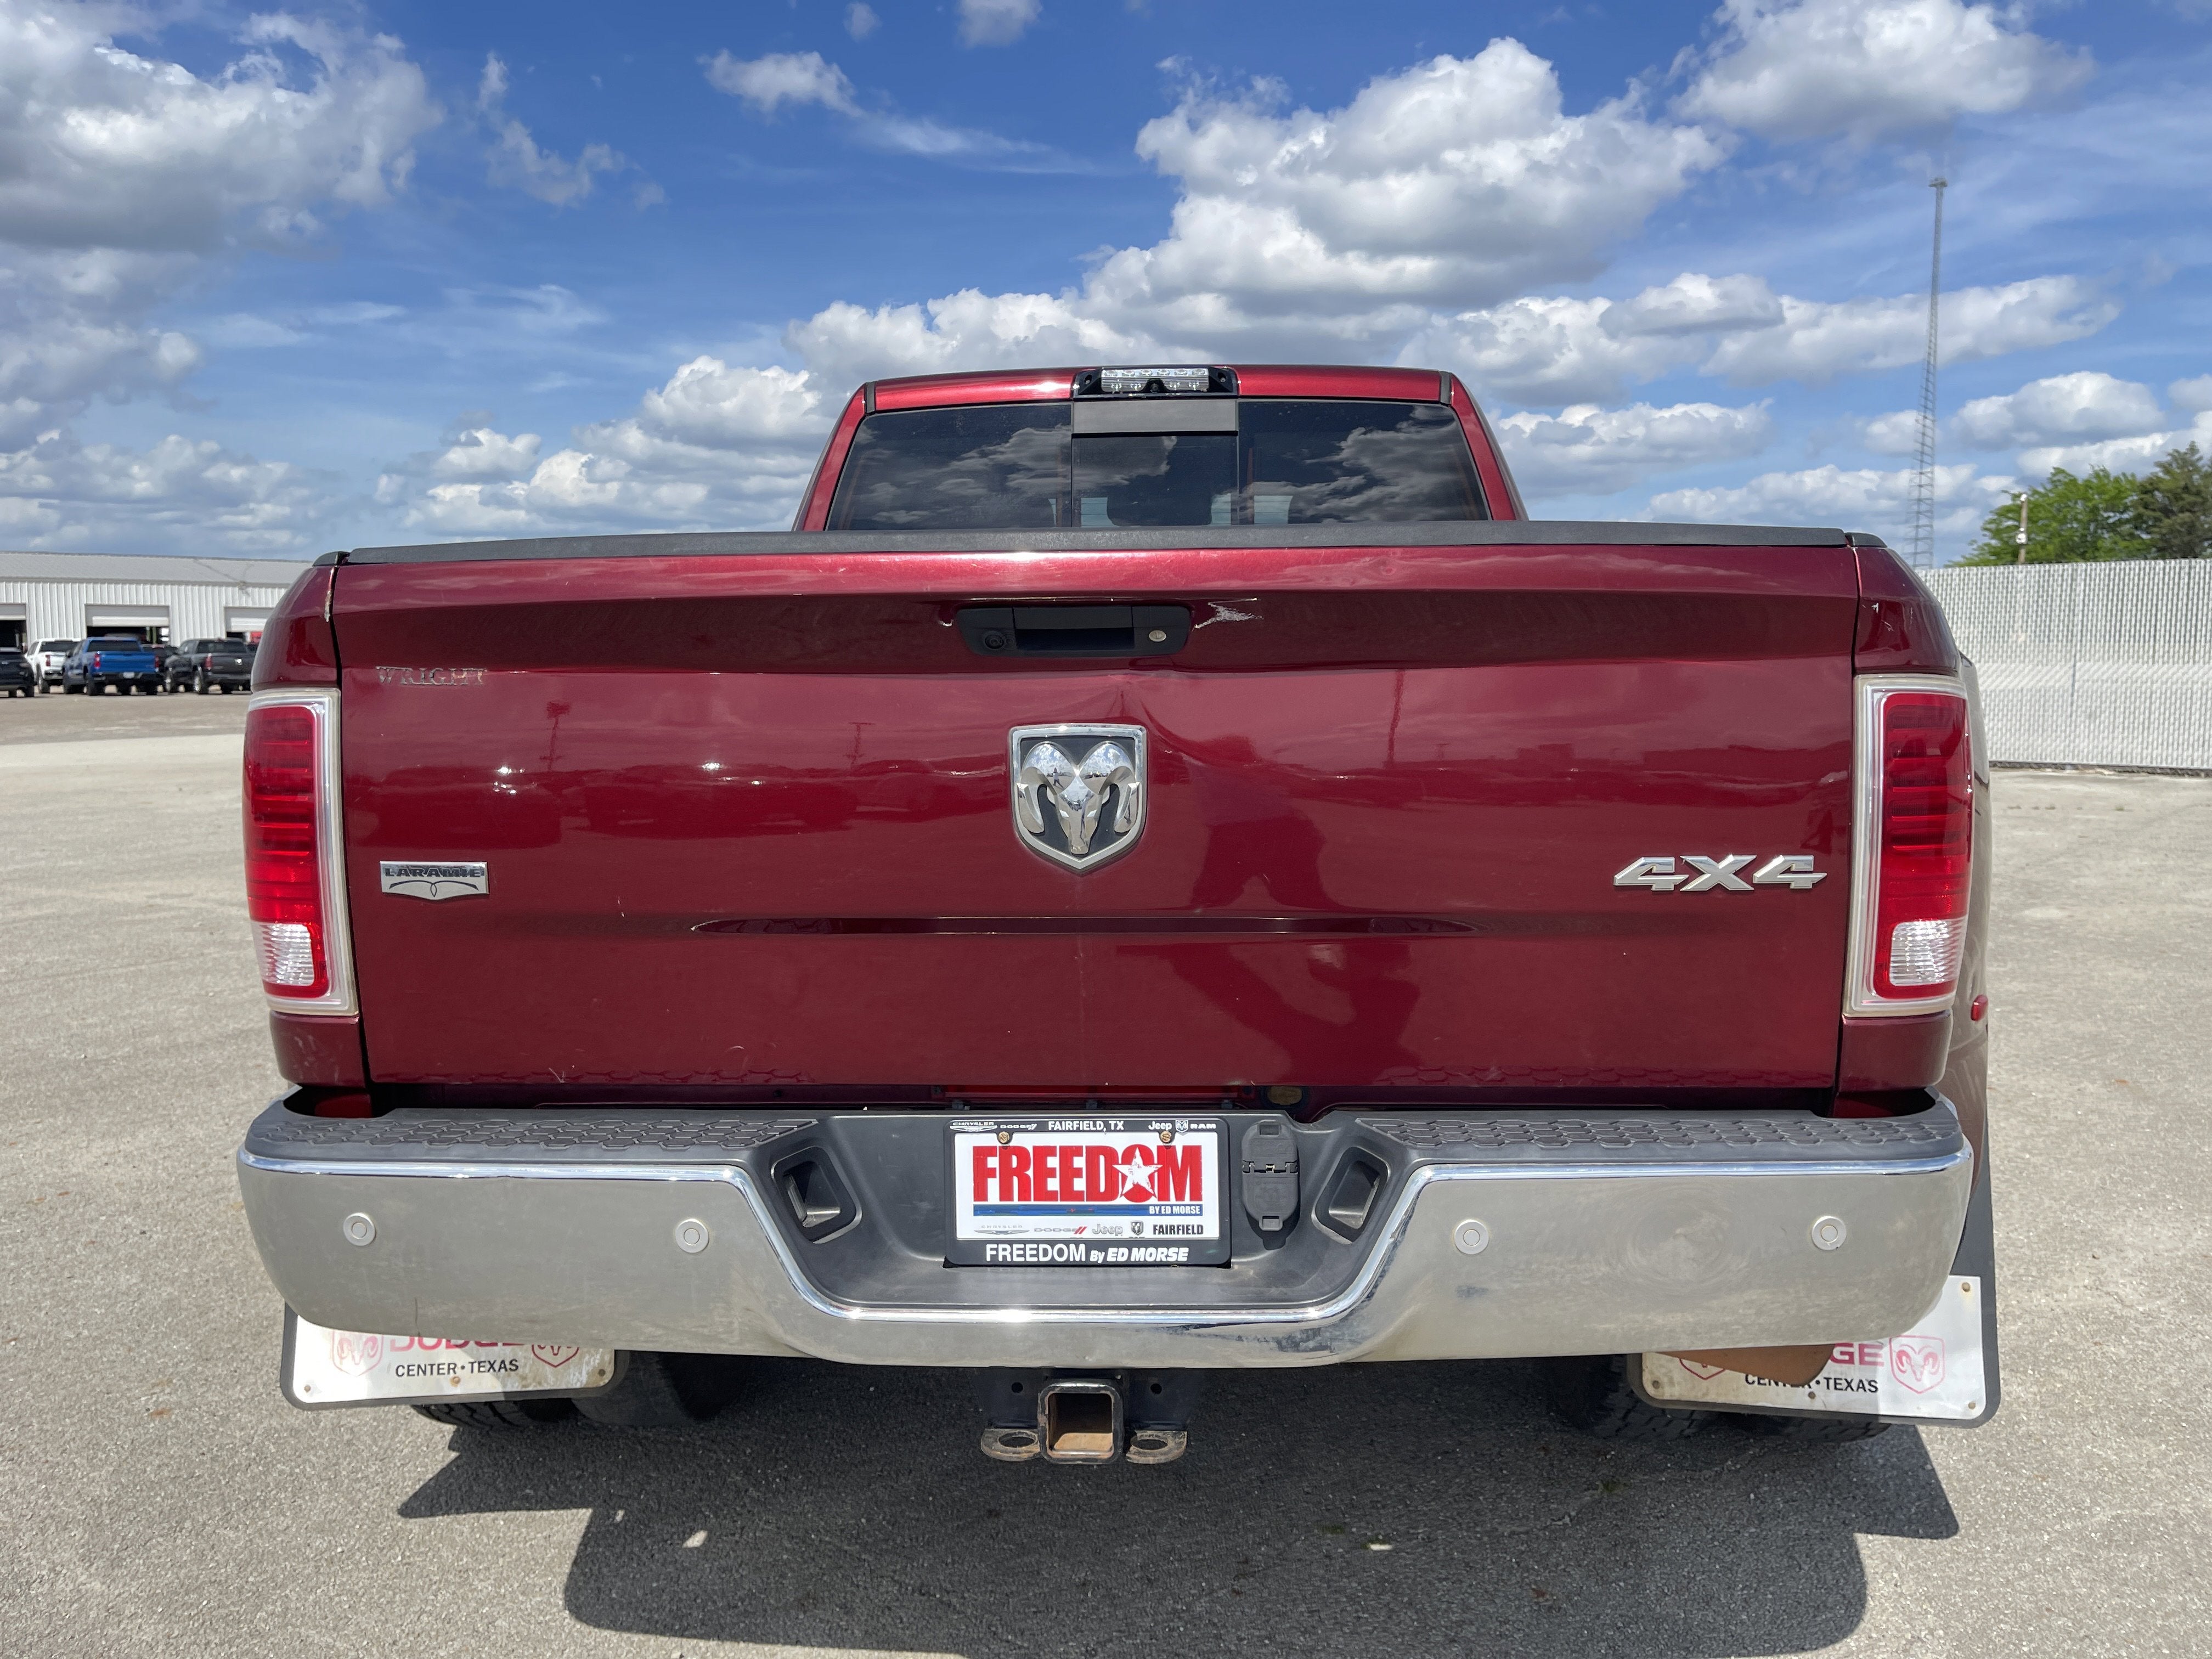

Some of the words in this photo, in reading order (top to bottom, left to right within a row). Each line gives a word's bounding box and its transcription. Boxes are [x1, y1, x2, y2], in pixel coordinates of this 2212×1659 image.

[385, 867, 481, 877] LARAMIE
[1048, 1121, 1107, 1132] FAIRFIELD,
[1109, 1121, 1124, 1130] TX
[1148, 1121, 1172, 1130] Jeep
[973, 1144, 1203, 1203] FREEDOM
[1149, 1206, 1159, 1214] BY
[1161, 1206, 1171, 1214] ED
[1172, 1206, 1200, 1214] MORSE
[1092, 1224, 1123, 1236] Jeep
[1153, 1224, 1204, 1235] FAIRFIELD
[986, 1244, 1086, 1262] FREEDOM
[1090, 1250, 1105, 1263] By
[1107, 1248, 1128, 1262] ED
[1130, 1247, 1189, 1262] MORSE
[396, 1362, 458, 1378] CENTER
[469, 1359, 519, 1374] TEXAS
[1823, 1377, 1878, 1392] TEXAS
